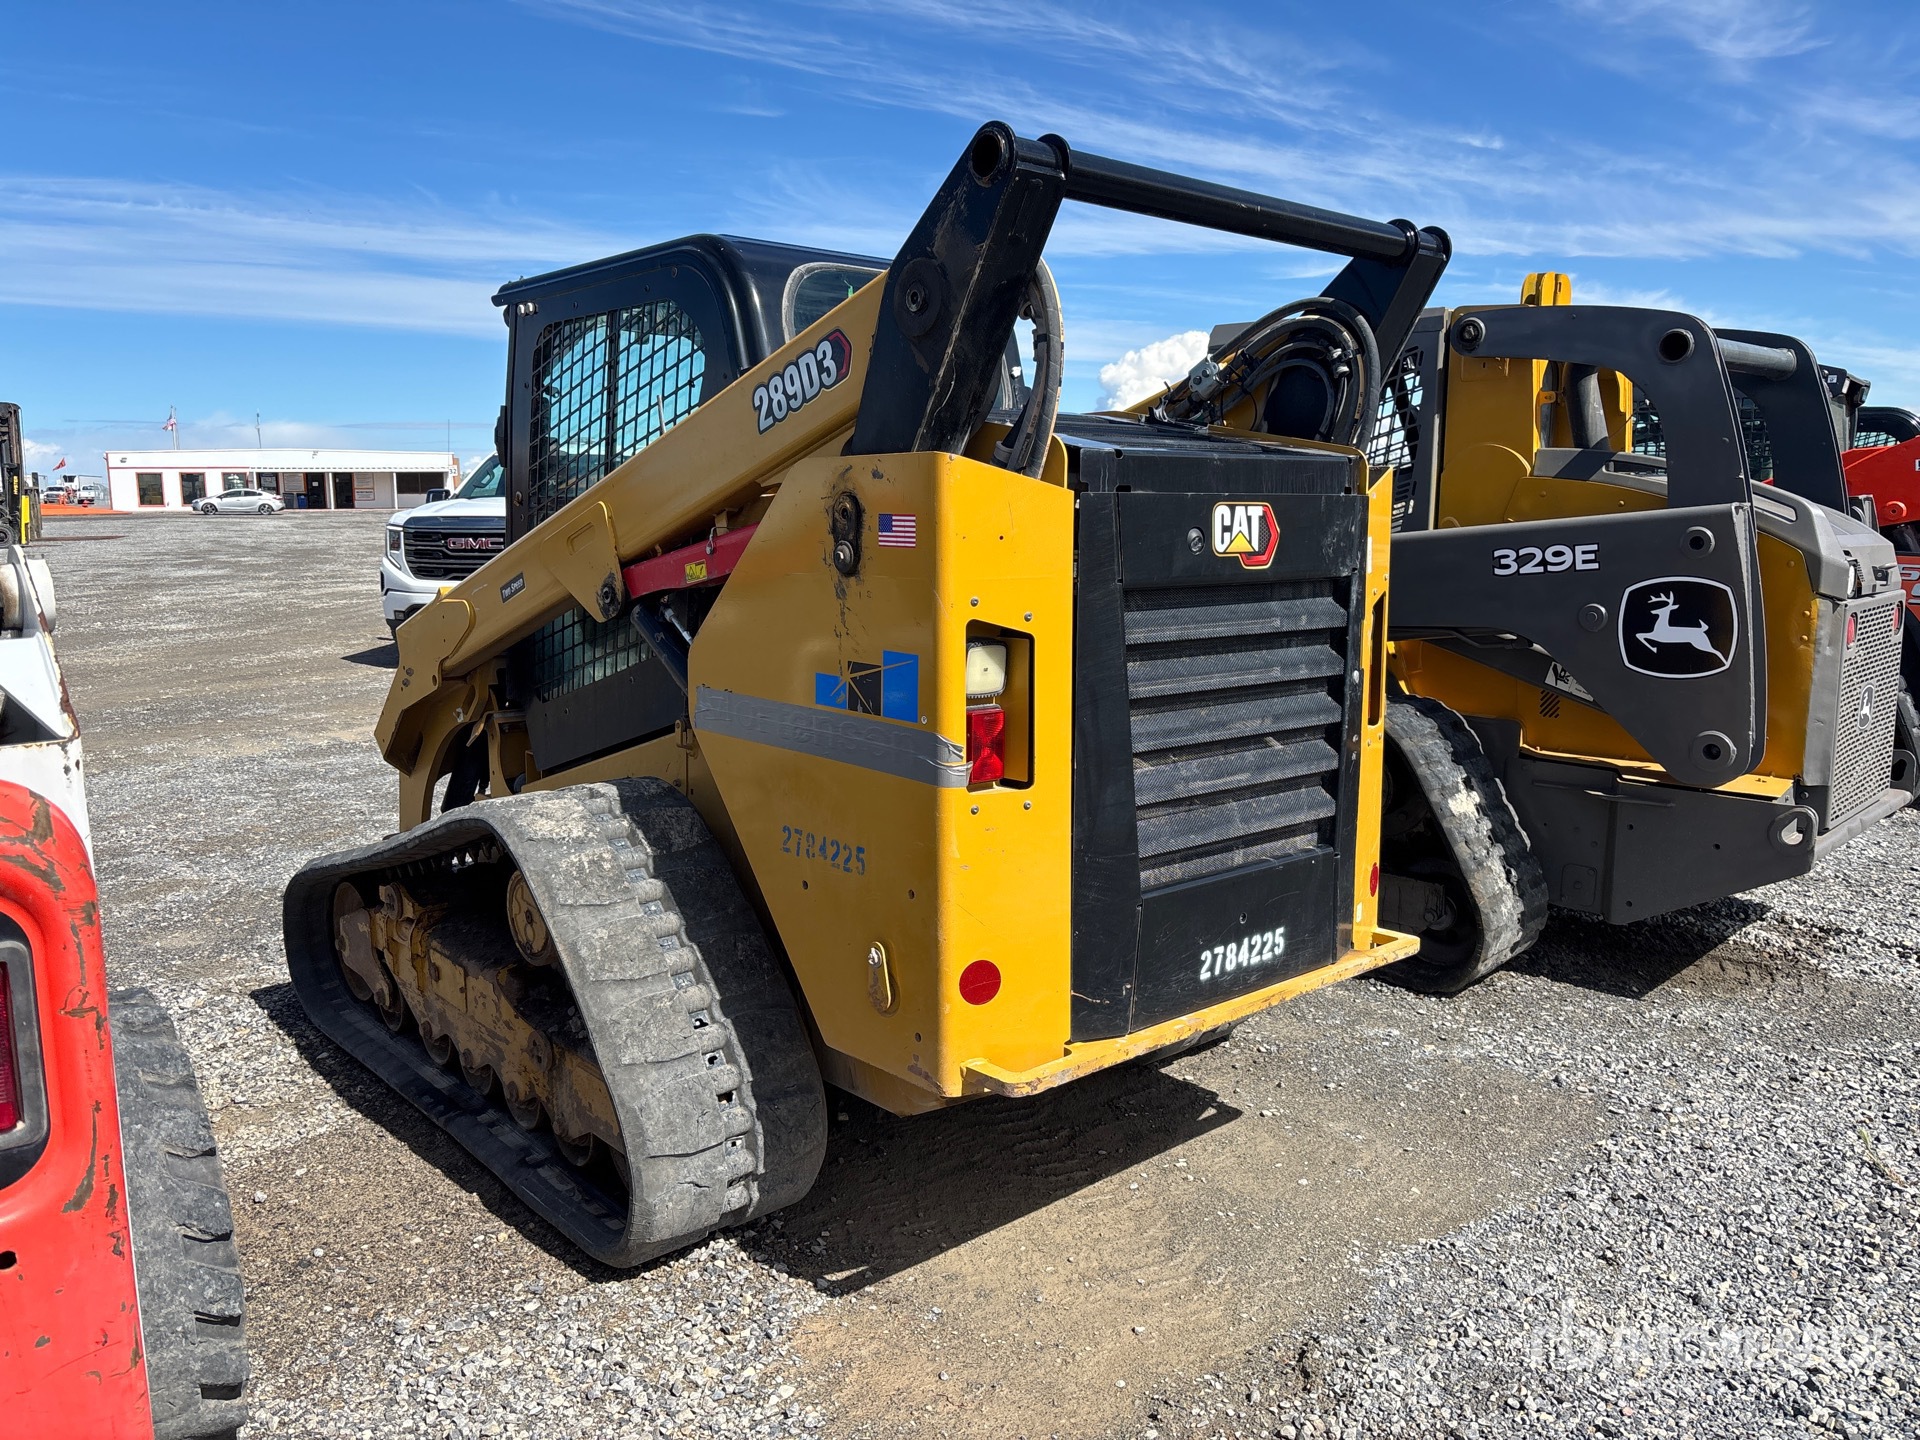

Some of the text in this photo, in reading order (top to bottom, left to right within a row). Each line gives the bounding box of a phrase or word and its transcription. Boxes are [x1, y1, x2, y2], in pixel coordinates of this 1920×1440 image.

[753, 340, 837, 432] 289D3
[447, 537, 505, 549] GMC
[1214, 504, 1264, 553] CAT
[1493, 543, 1600, 576] 329E
[782, 824, 866, 876] 2784225
[1199, 926, 1285, 981] 2784225
